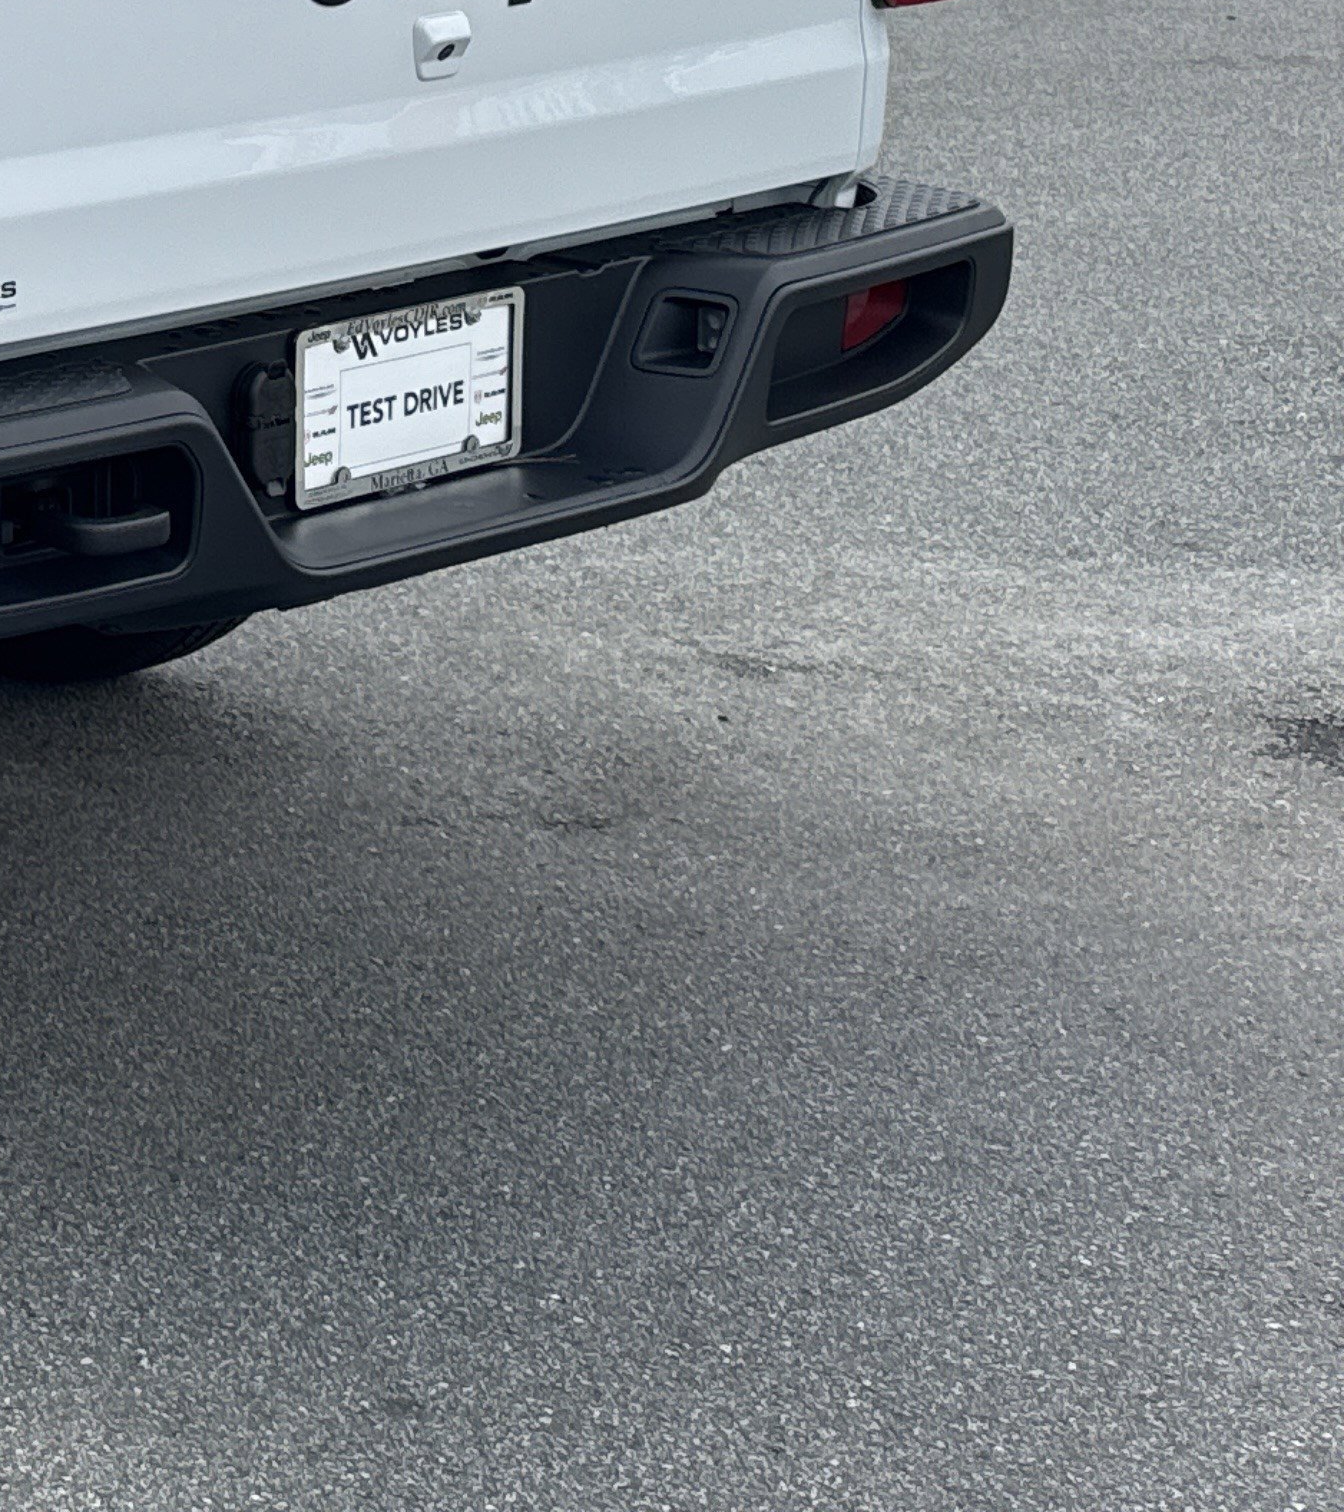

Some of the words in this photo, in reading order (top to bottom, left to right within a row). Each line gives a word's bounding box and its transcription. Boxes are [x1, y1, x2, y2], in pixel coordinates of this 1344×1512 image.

[380, 313, 463, 346] VOYLES
[346, 394, 397, 429] TEST
[403, 379, 464, 417] DRIVE
